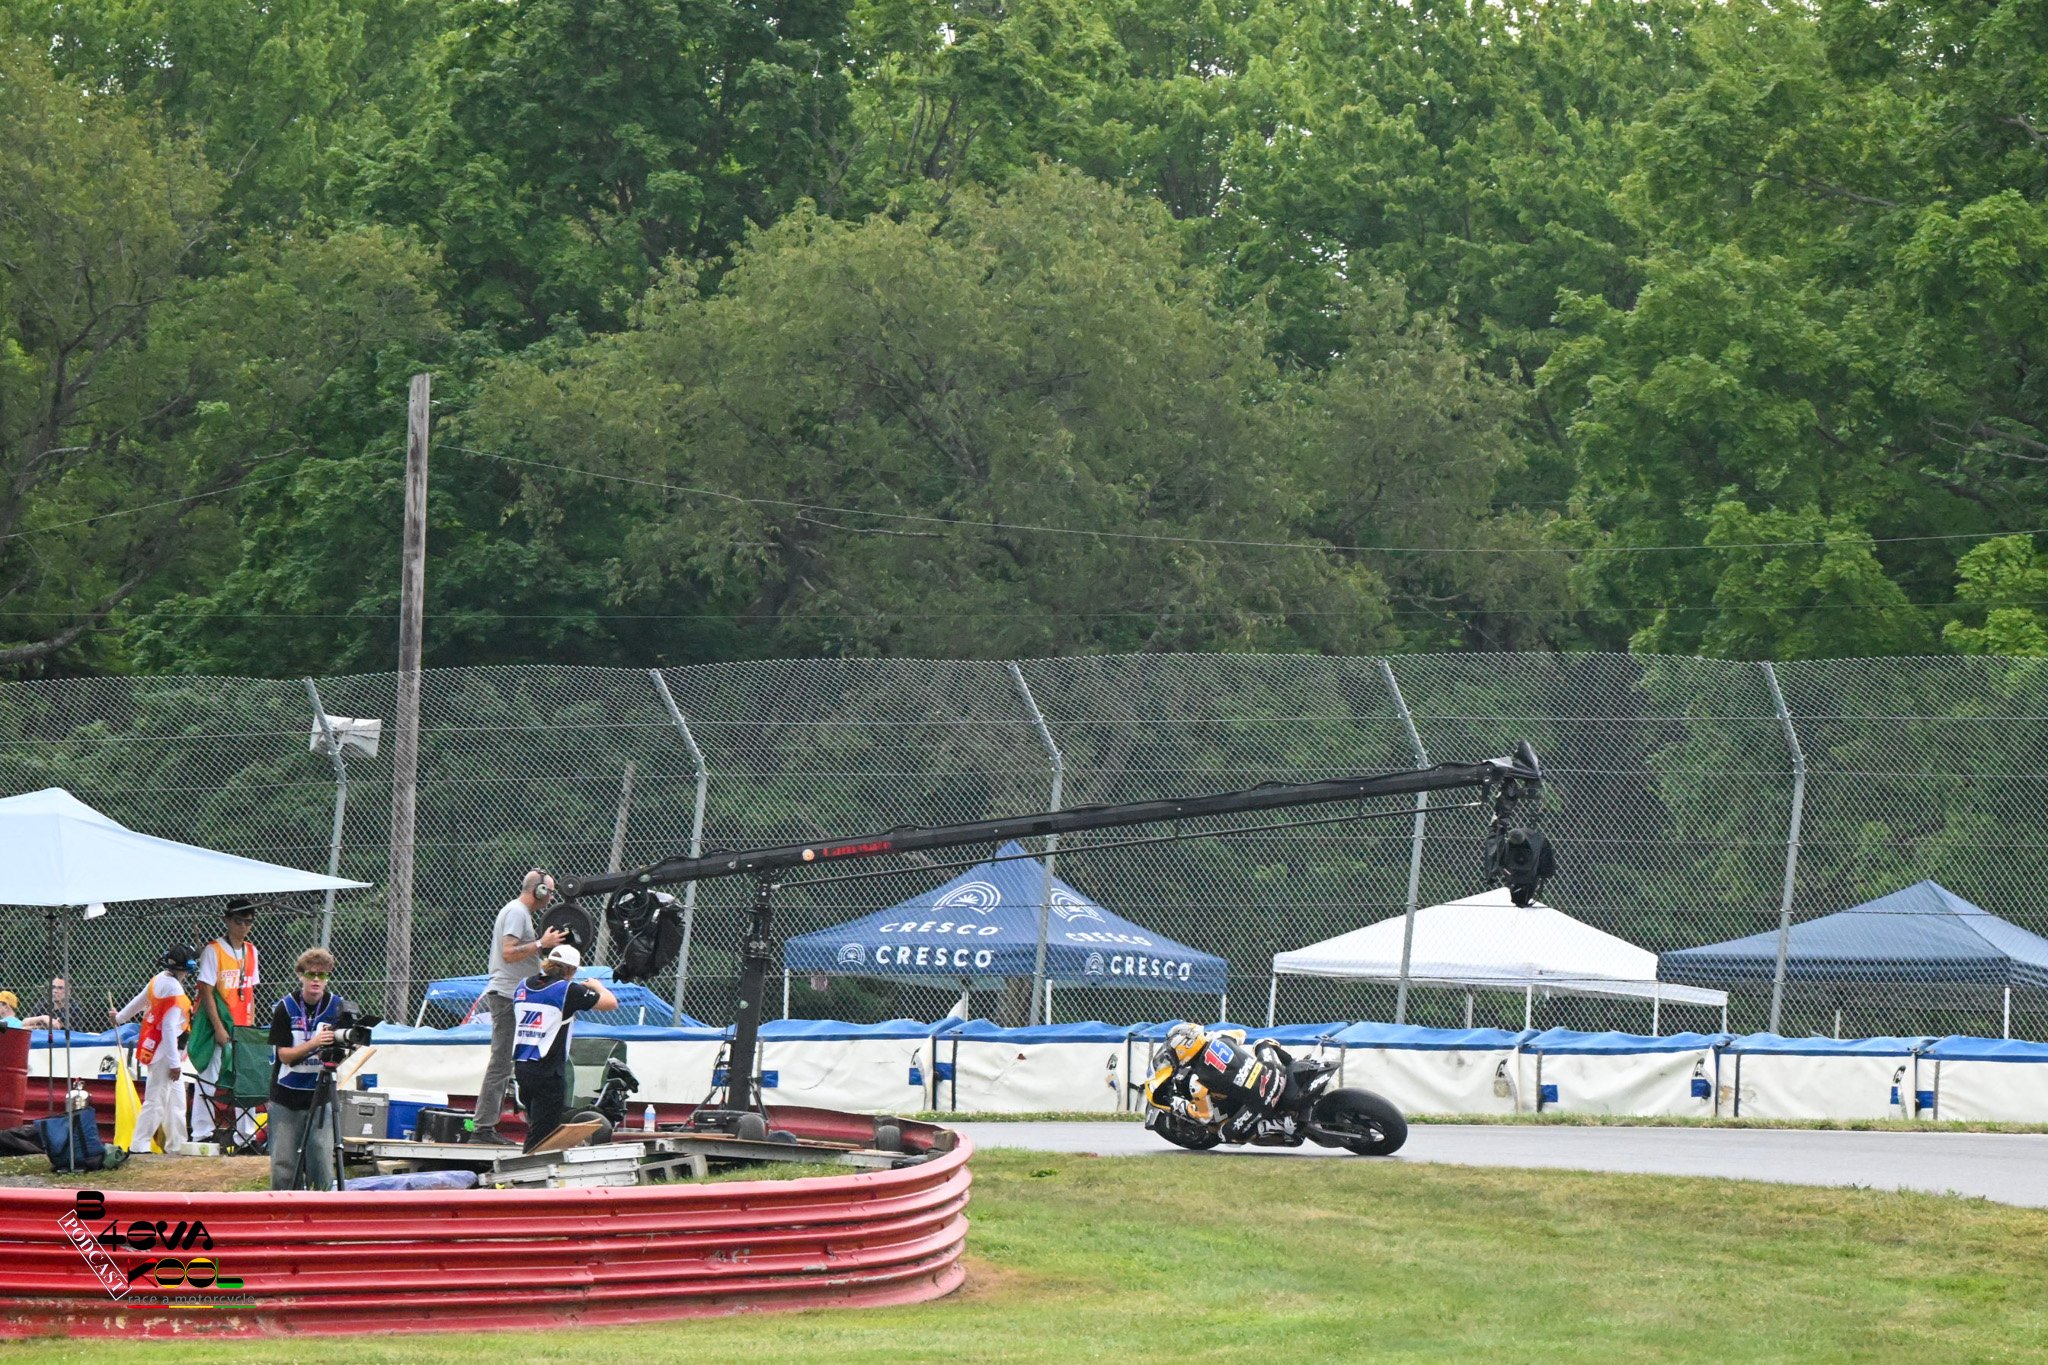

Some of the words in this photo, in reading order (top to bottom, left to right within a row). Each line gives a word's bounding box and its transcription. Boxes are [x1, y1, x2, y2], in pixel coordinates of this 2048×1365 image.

[879, 921, 999, 936] CRESCO
[1065, 932, 1152, 947] CRESCO
[876, 945, 992, 968] CRESCO
[1110, 956, 1190, 981] CRESCO
[1204, 1040, 1234, 1073] 15
